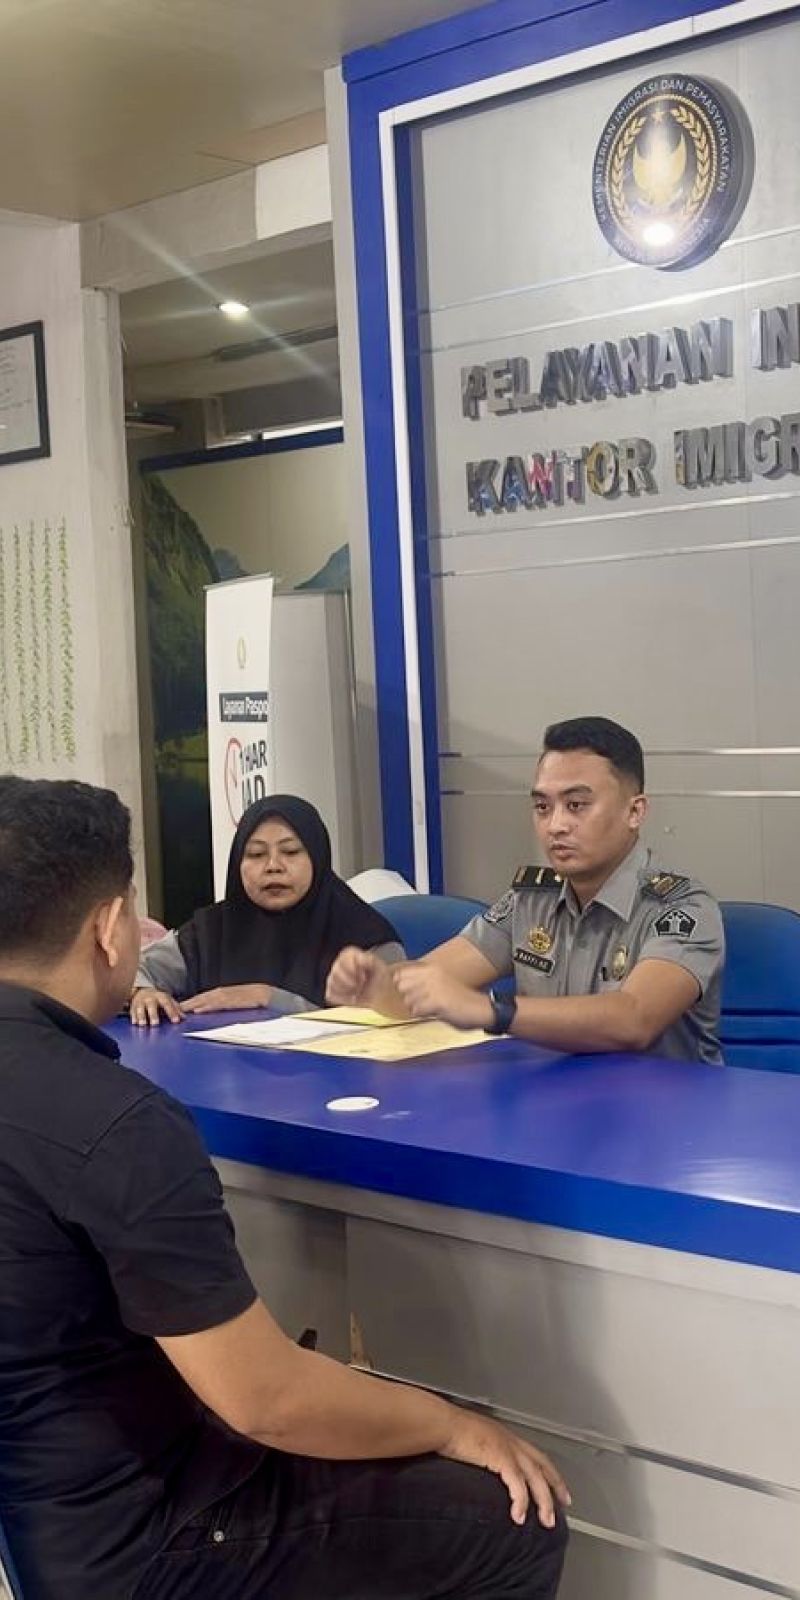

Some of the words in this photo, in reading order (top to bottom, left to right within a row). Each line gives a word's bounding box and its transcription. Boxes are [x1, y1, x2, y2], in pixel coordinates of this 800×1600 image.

[614, 81, 659, 123] IMIGRASI
[661, 79, 684, 90] DAN
[685, 83, 731, 193] PEMASYARAKATAN
[461, 317, 733, 420] PELAYANAN
[465, 436, 659, 516] KANTOR
